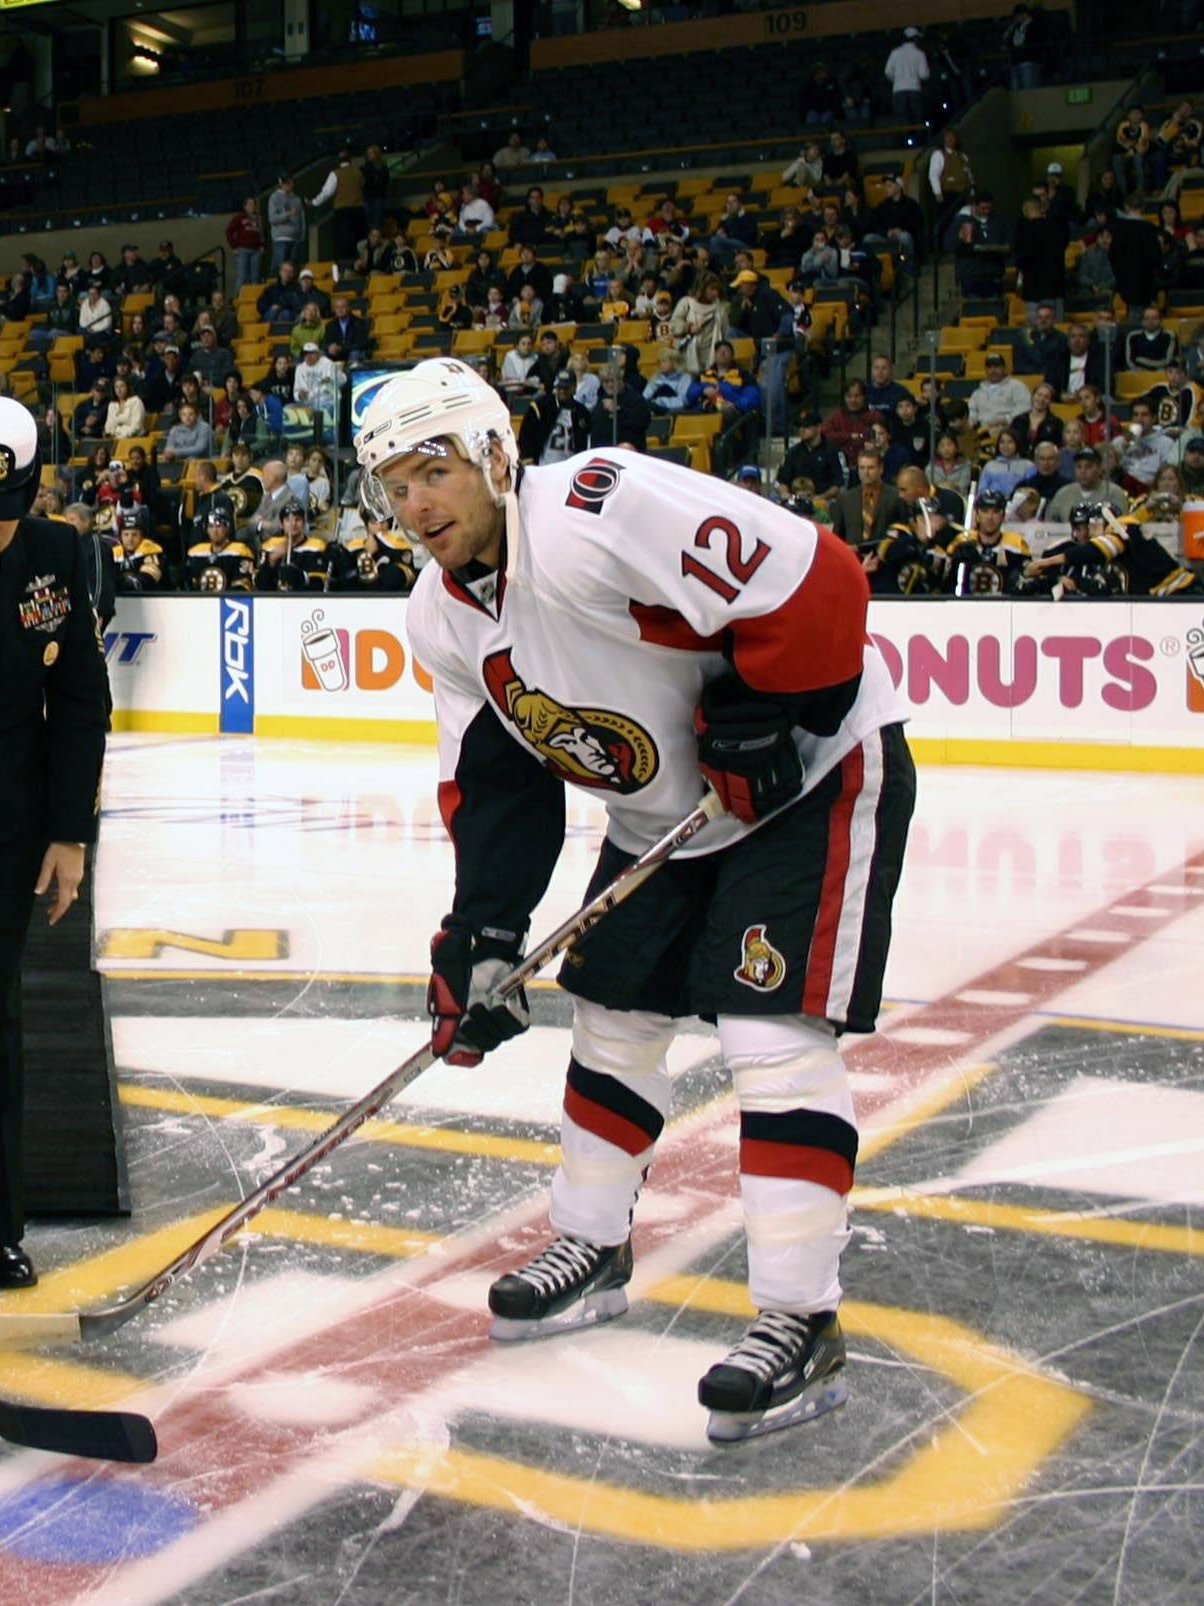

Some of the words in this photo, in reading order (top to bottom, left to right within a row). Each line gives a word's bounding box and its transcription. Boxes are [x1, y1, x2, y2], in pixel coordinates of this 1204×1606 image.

[765, 11, 806, 33] 109
[681, 515, 772, 605] 12
[320, 660, 336, 673] DD
